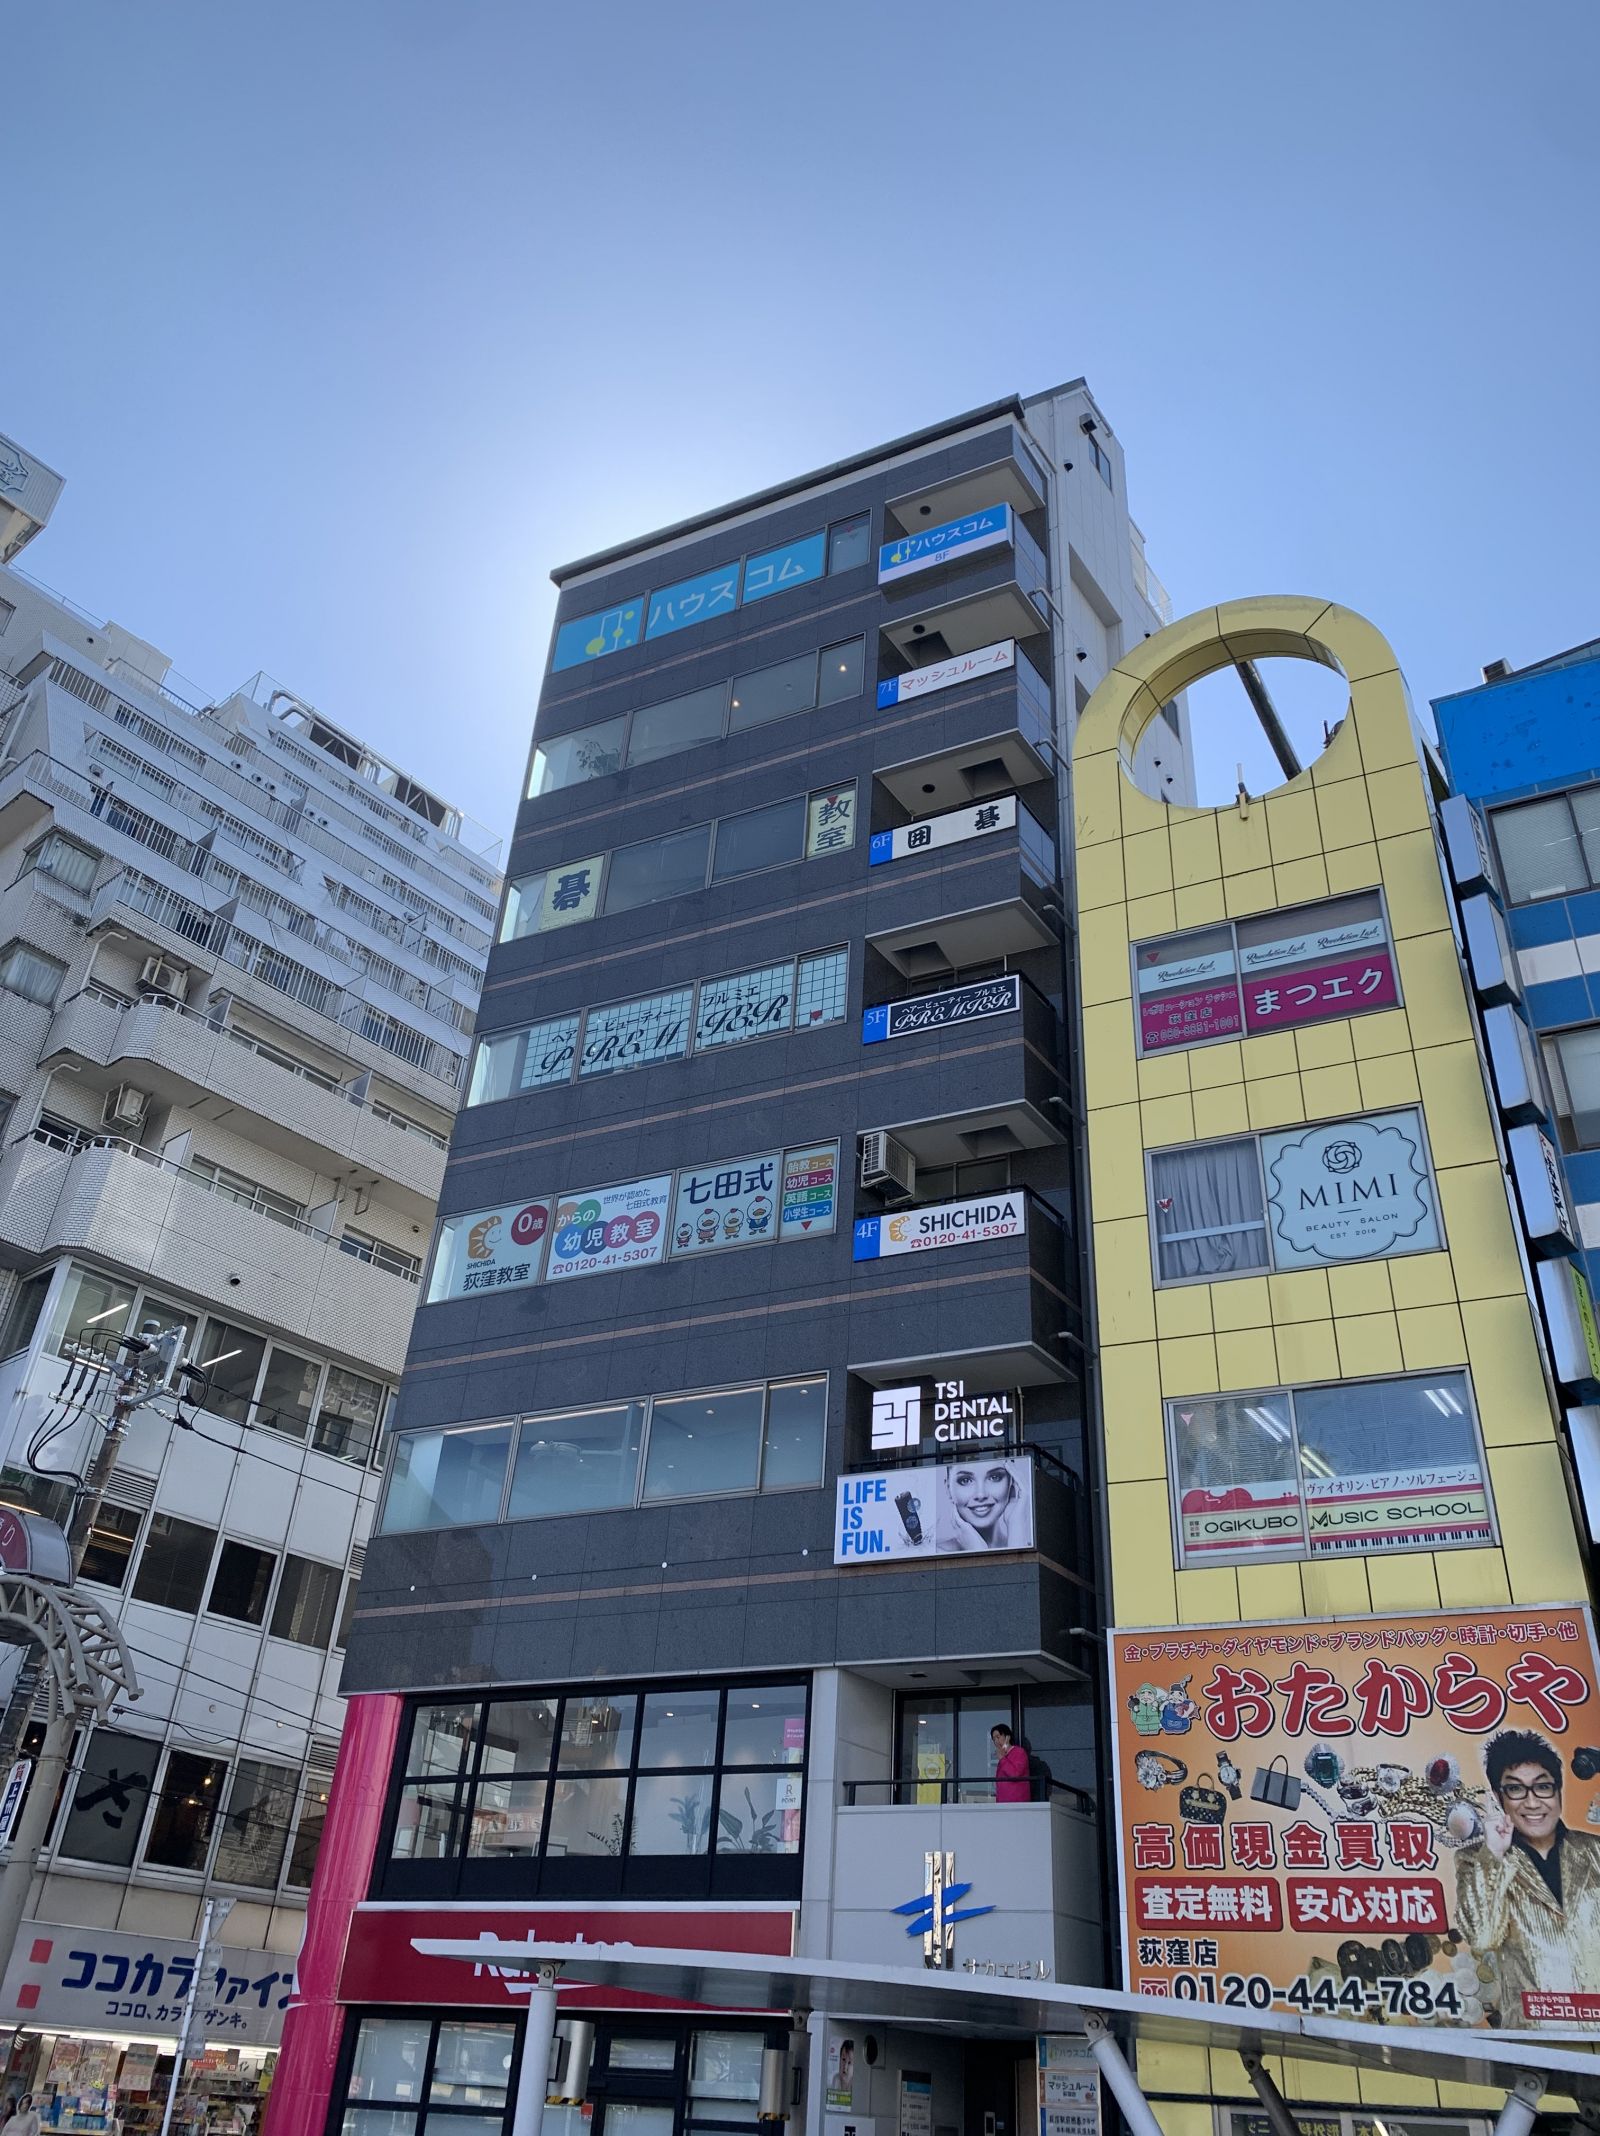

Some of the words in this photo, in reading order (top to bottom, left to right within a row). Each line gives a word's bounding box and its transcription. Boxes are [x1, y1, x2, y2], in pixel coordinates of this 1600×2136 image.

[916, 518, 993, 551] ハウスコム
[934, 551, 950, 562] 8F
[650, 558, 805, 628] ハウスコム
[901, 650, 1008, 690] マッシュルーム
[879, 681, 897, 694] 7F
[815, 799, 852, 851] 教室
[872, 833, 891, 849] 6F
[552, 869, 591, 912] 碁
[1254, 968, 1383, 1016] まつエク
[867, 1009, 886, 1025] 5F
[683, 1163, 773, 1204] 七田式
[786, 1174, 832, 1189] 幼児コース
[1300, 1173, 1400, 1210] MIMI
[785, 1189, 832, 1205] 英語コース
[557, 1208, 596, 1228] からの
[784, 1205, 831, 1221] 小学生コース
[919, 1202, 1017, 1234] SHICHIDA
[1305, 1220, 1350, 1232] BEAUTY
[1360, 1213, 1399, 1224] SALON
[564, 1219, 655, 1251] 幼児教室
[857, 1222, 879, 1239] 4F
[923, 1222, 1018, 1247] 0120-41-5307
[466, 1260, 496, 1270] SHICHIDA
[565, 1247, 658, 1274] 0120-41-5307
[463, 1263, 530, 1292] 荻窪教室
[935, 1380, 964, 1399] TSI
[934, 1396, 1013, 1421] DENTAL
[934, 1419, 1004, 1442] CLINIC
[843, 1479, 887, 1505] LIFE
[842, 1506, 863, 1530] IS
[1204, 1515, 1298, 1534] OGIKUBO
[1310, 1510, 1379, 1531] MUSIC
[1386, 1501, 1485, 1520] SCHOOL
[841, 1530, 891, 1555] FUN.
[1202, 1652, 1590, 1741] おたからや
[1132, 1821, 1438, 1871] 高価現金買取
[1142, 1885, 1272, 1922] 査定無料
[1295, 1886, 1437, 1922] 安心対応
[1137, 1938, 1218, 1968] 荻窪店
[1173, 1975, 1463, 2016] 0120-444-784
